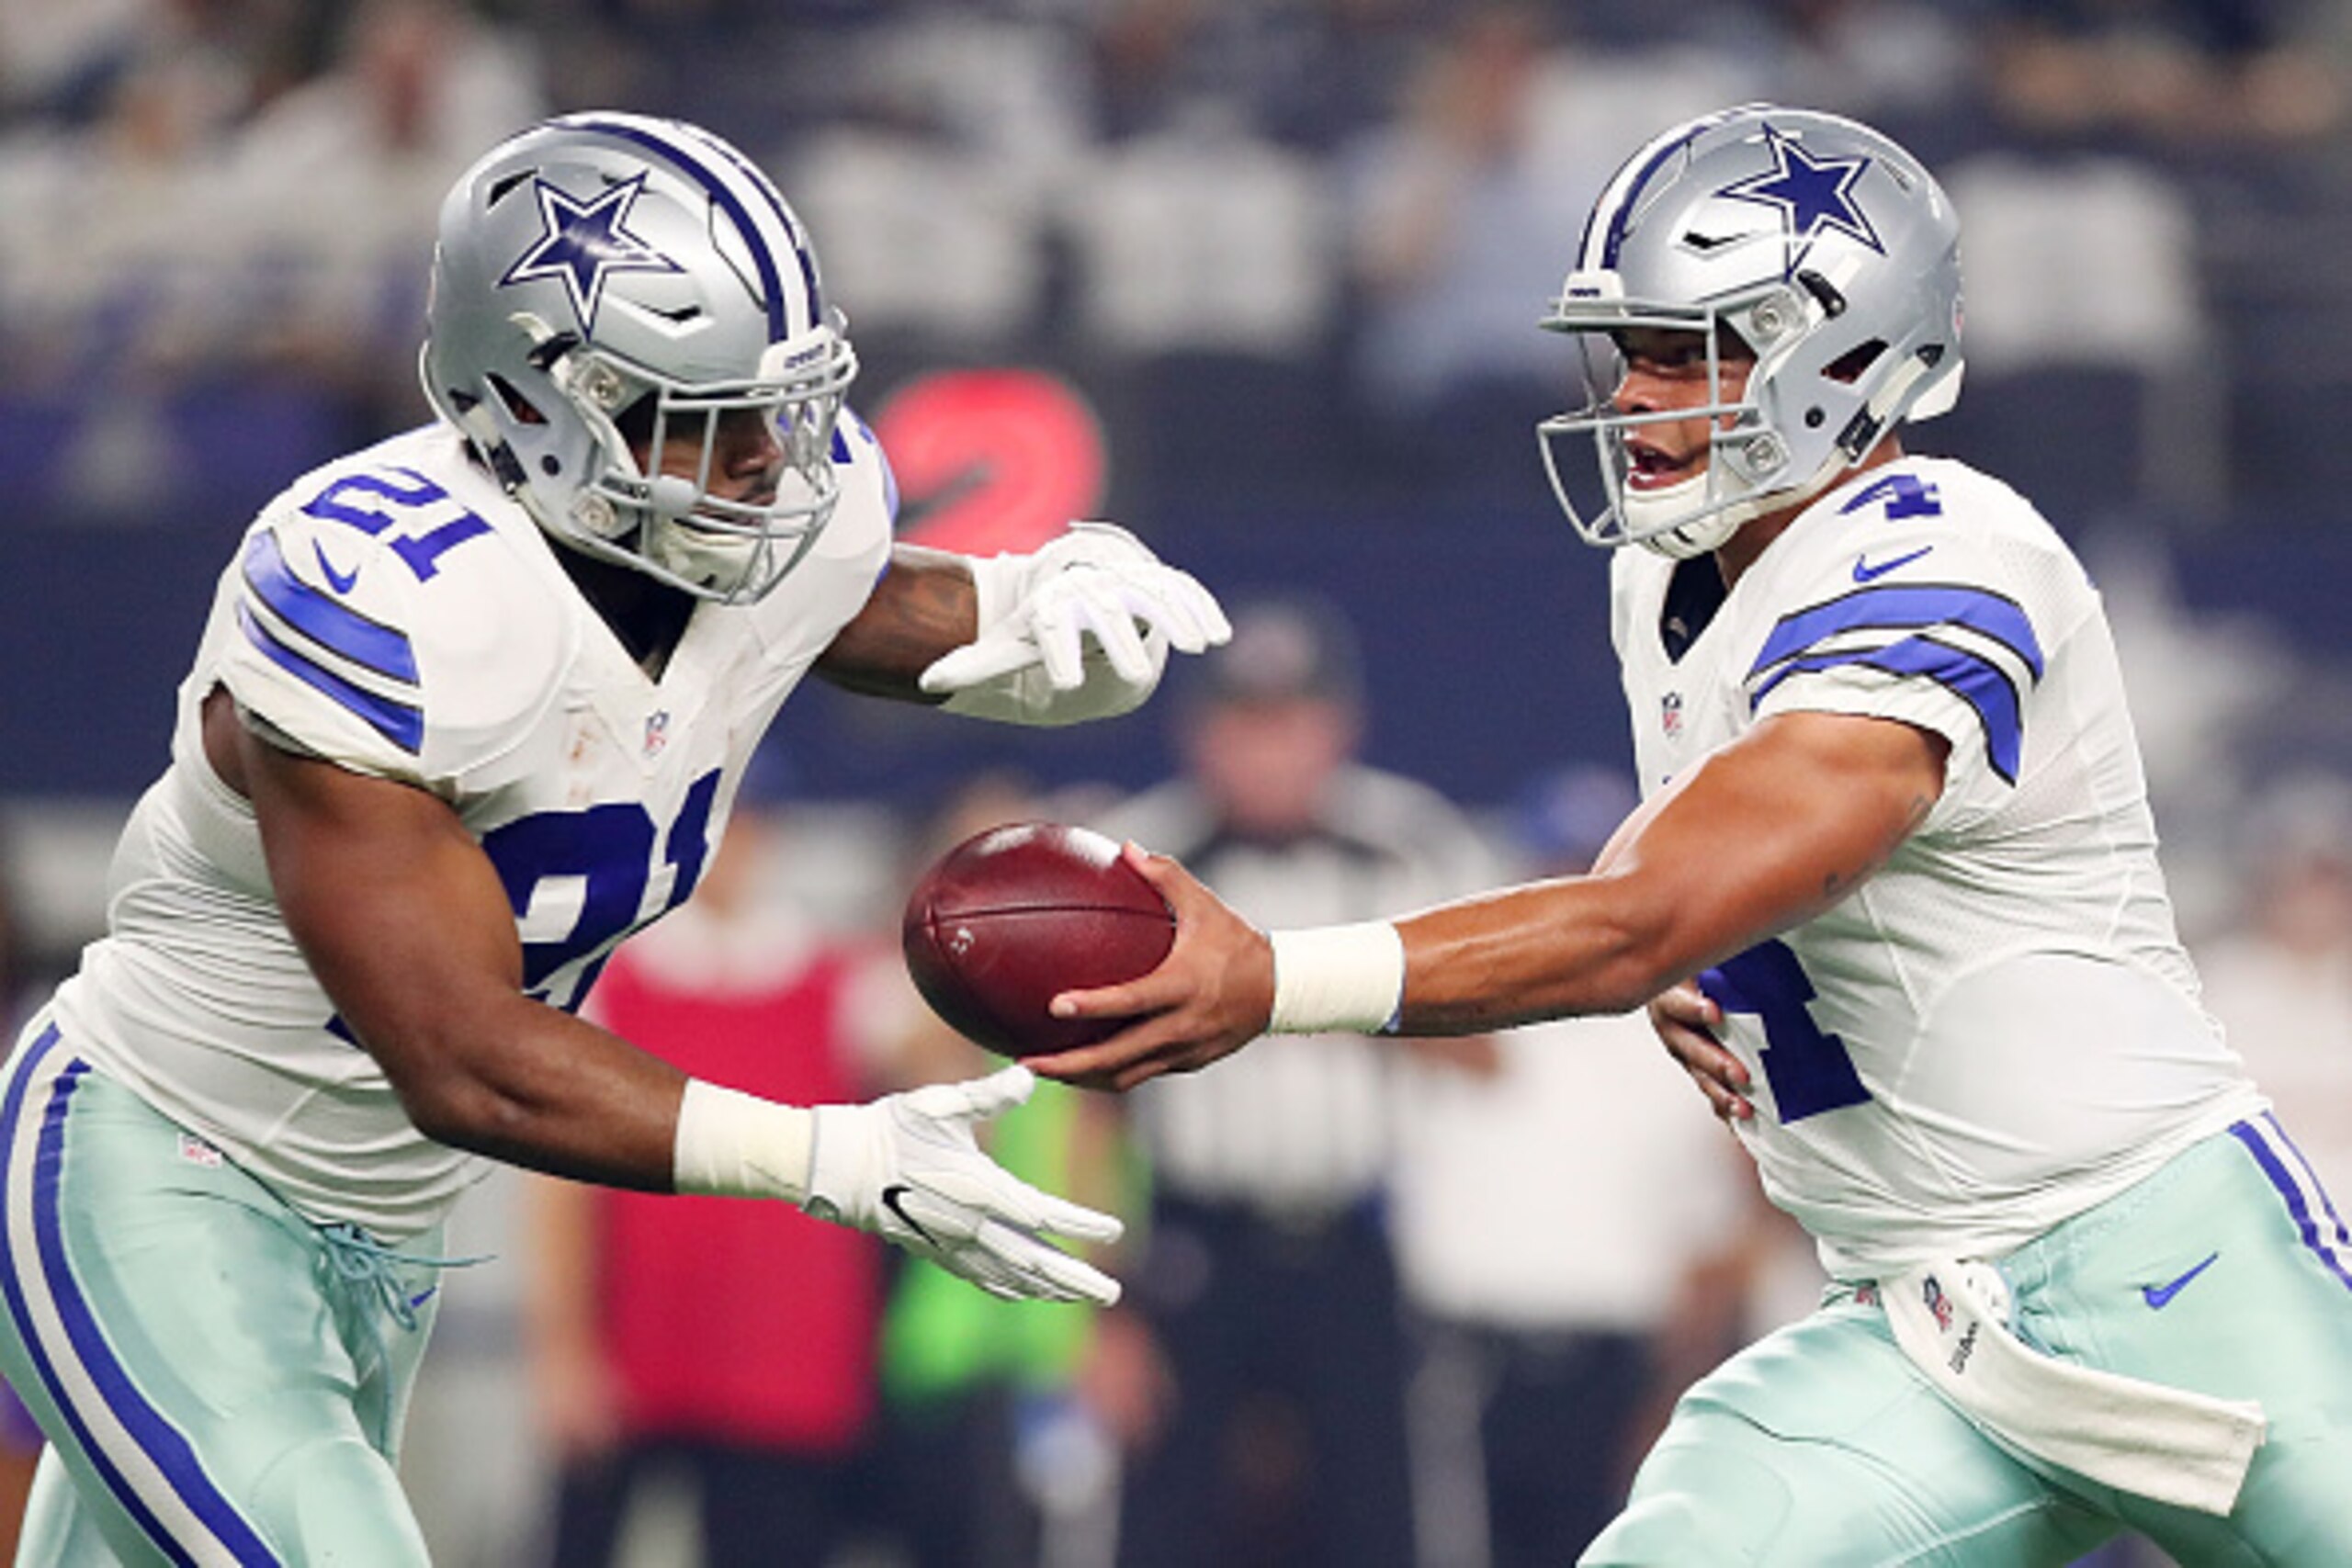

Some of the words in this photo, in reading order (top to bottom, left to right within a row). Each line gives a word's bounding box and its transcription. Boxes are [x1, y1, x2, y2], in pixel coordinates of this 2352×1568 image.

[300, 465, 494, 583] 21
[873, 367, 1105, 558] 2
[1837, 474, 1942, 520] 4
[480, 767, 723, 1016] 21
